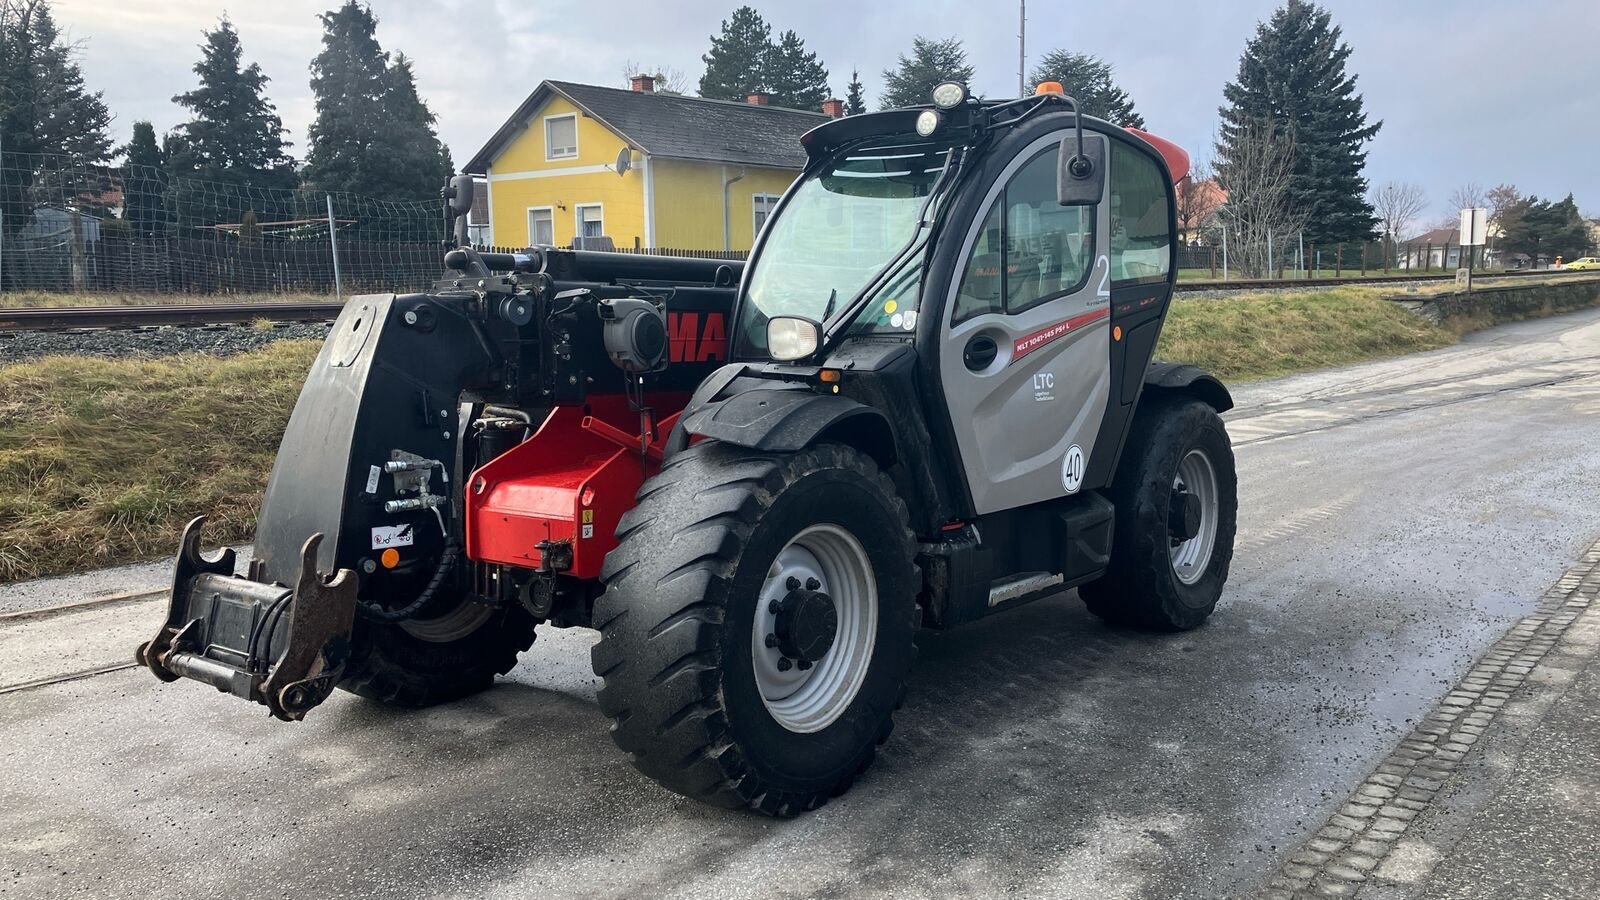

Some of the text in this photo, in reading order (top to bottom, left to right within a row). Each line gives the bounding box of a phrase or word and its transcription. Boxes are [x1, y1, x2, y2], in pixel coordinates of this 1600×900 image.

[1016, 341, 1029, 352] MLT
[1029, 330, 1054, 346] 1041-145
[1055, 324, 1065, 334] PS+
[1033, 373, 1054, 389] LTC
[1066, 453, 1081, 483] 40
